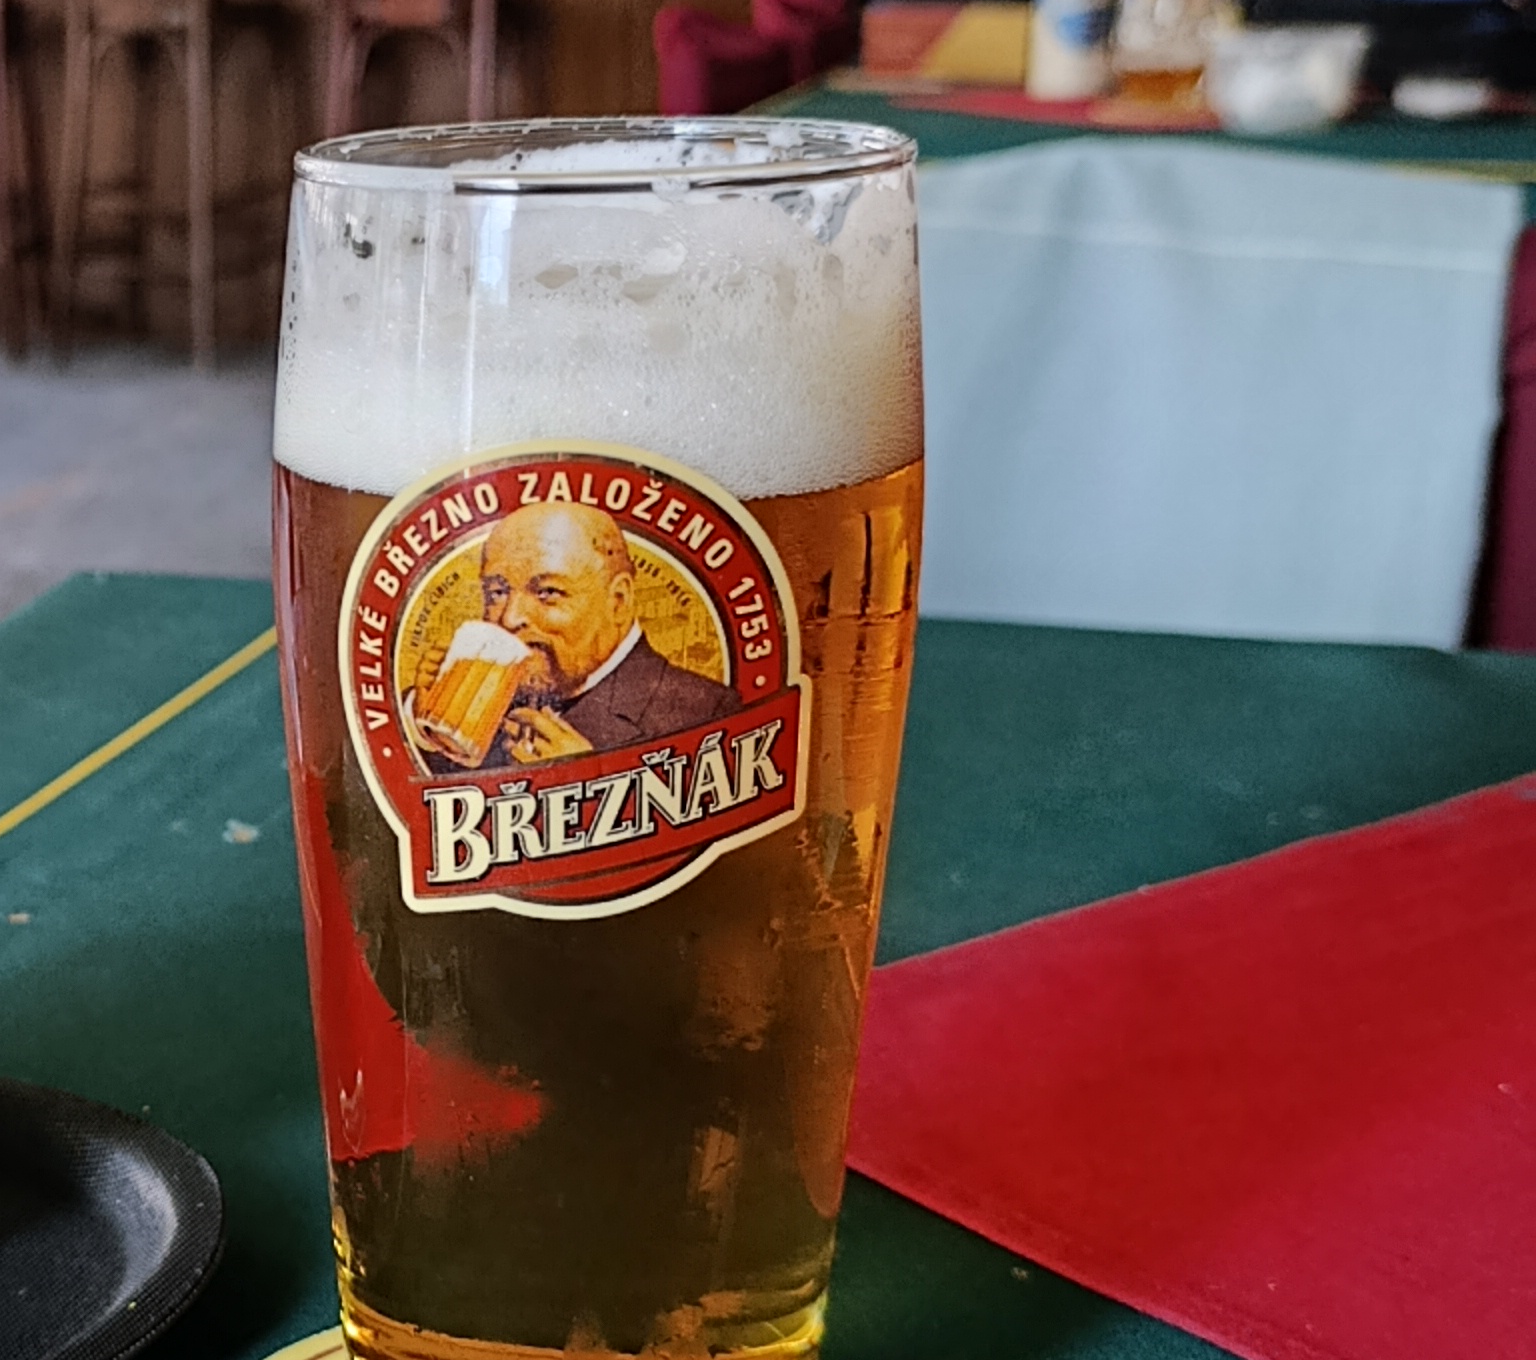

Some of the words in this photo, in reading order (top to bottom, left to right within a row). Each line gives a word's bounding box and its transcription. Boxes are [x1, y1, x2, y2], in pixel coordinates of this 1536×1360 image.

[357, 605, 388, 730] VELKÉ
[374, 481, 499, 597] BŘEZNO
[518, 471, 735, 571] ZALOŽENO
[728, 576, 773, 660] 1753
[423, 720, 784, 884] BŘEZŇÁK
